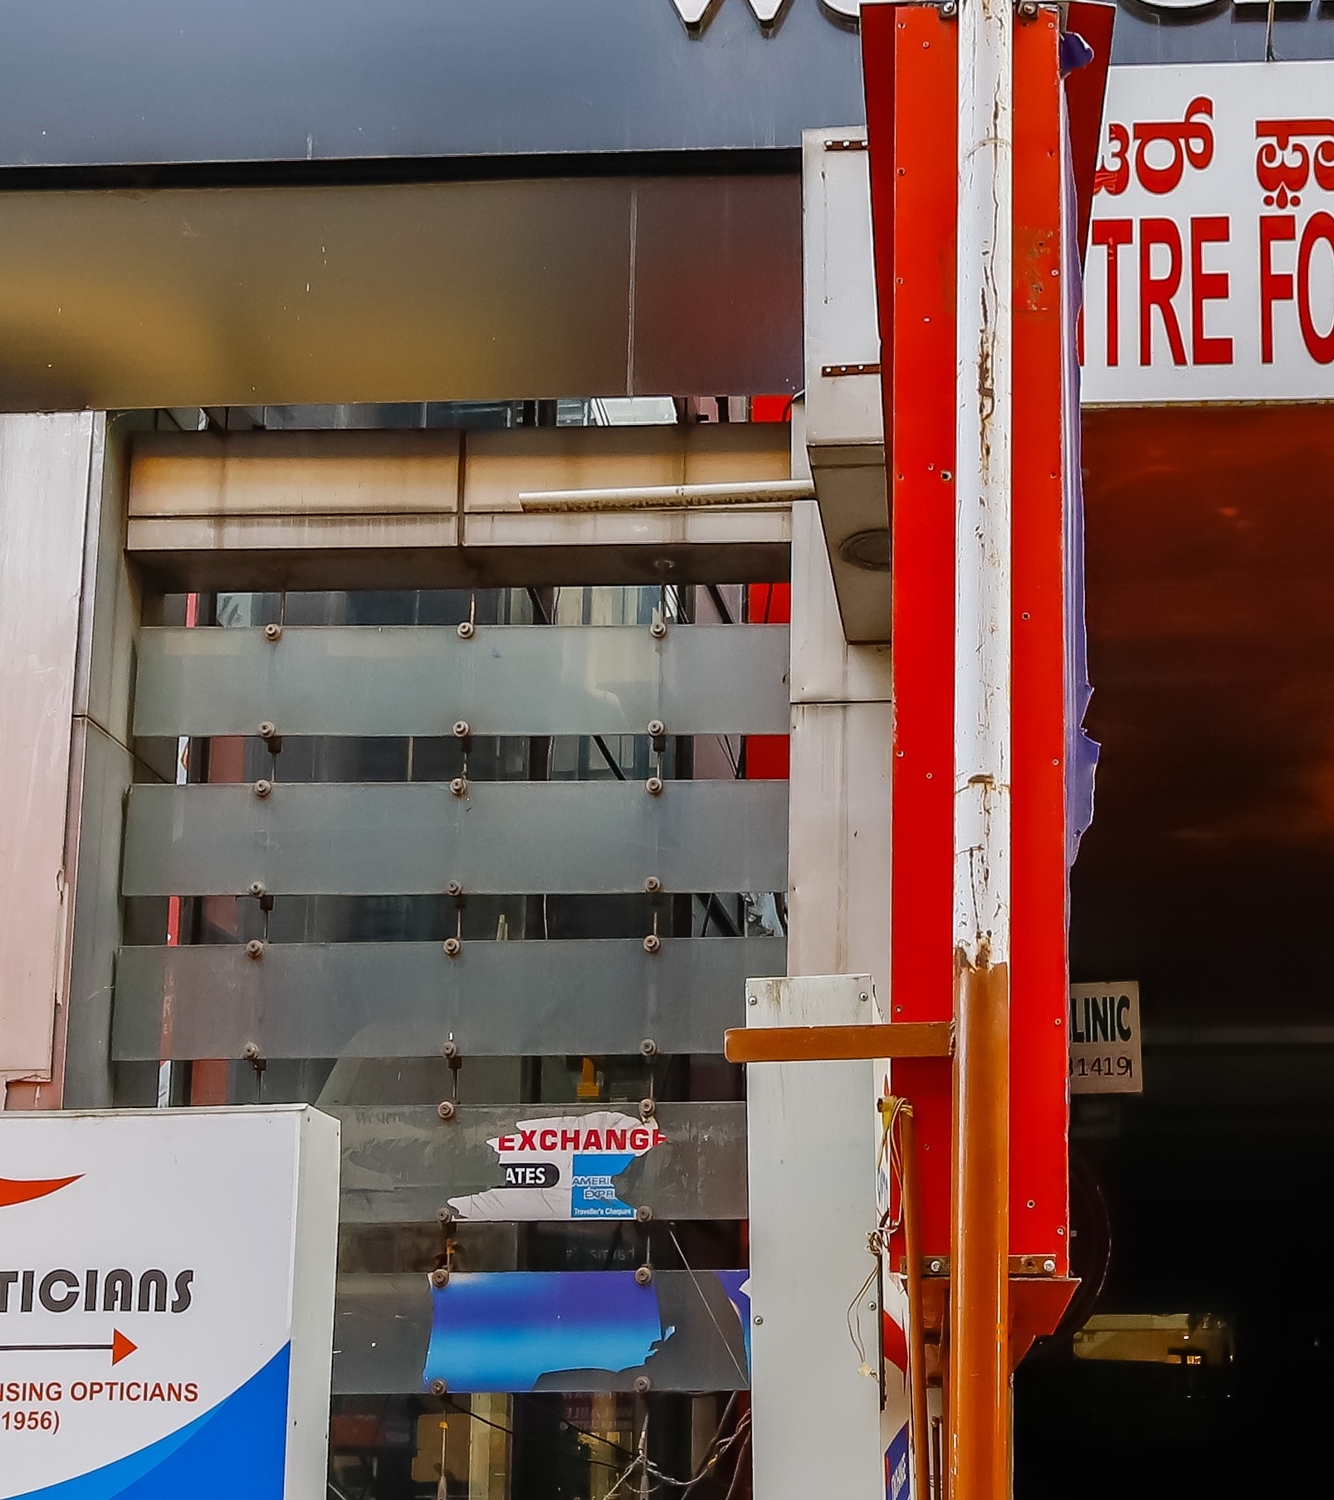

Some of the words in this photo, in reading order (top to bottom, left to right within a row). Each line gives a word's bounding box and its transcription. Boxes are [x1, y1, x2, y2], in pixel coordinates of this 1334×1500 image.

[1077, 216, 1233, 367] TRE
[1070, 995, 1132, 1043] LINIC
[69, 1380, 200, 1404] OPTICIANS
[1, 1410, 61, 1435] 1956)
